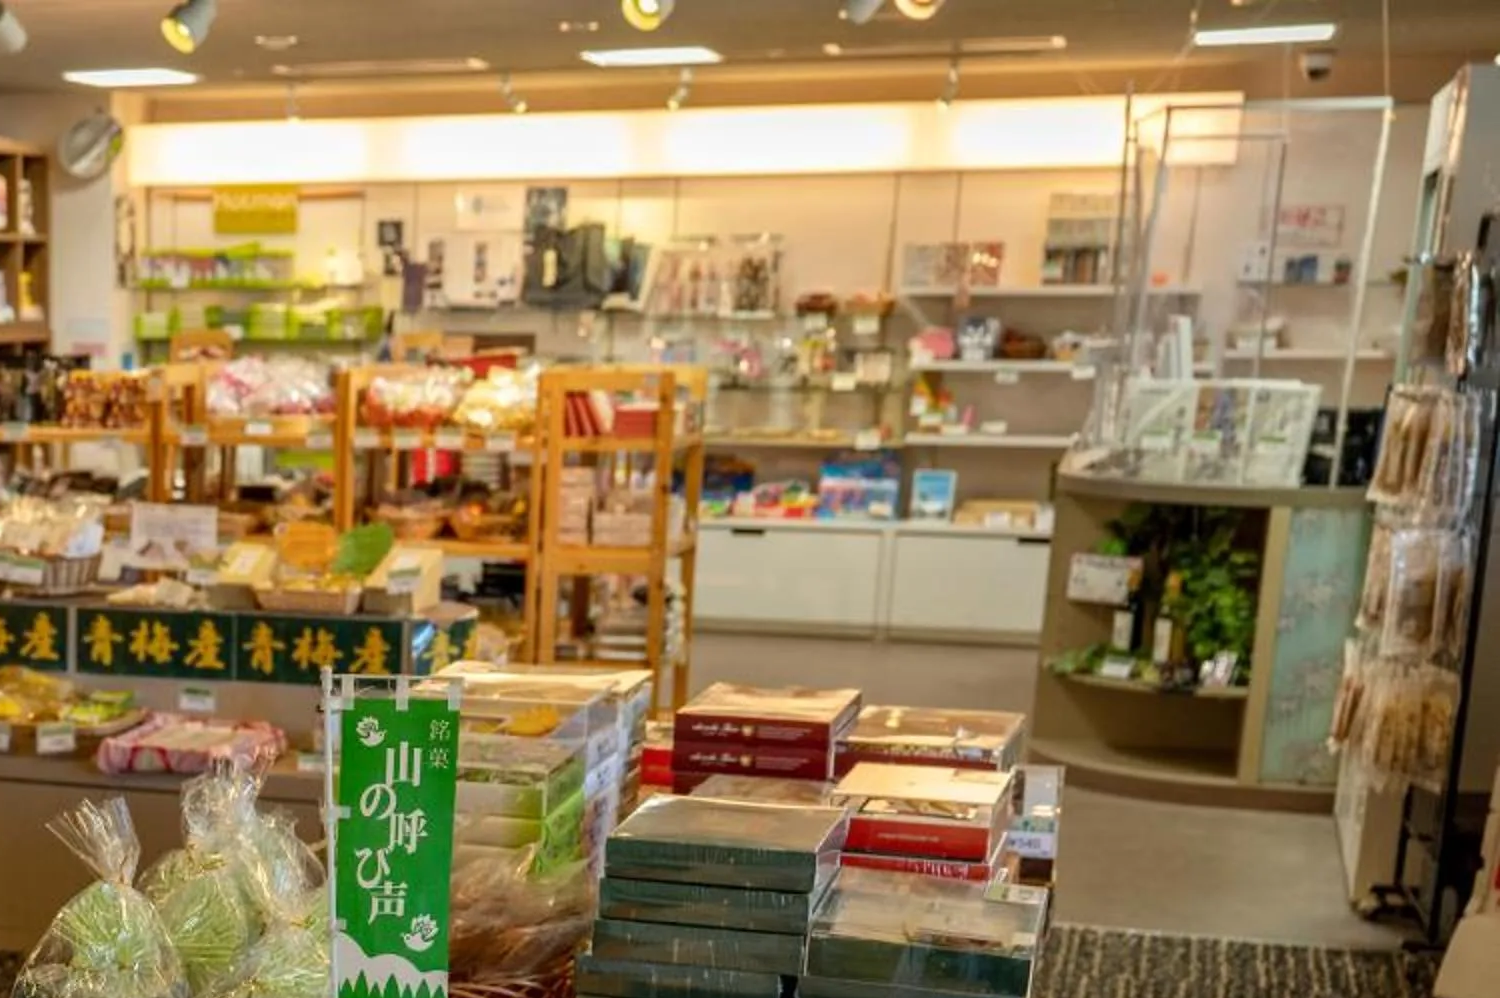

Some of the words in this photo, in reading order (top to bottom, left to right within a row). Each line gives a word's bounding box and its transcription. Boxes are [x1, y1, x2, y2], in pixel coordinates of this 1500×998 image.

[83, 613, 225, 670] 青梅産
[430, 718, 450, 769] 銘菓
[355, 741, 428, 925] 山の呼び声
